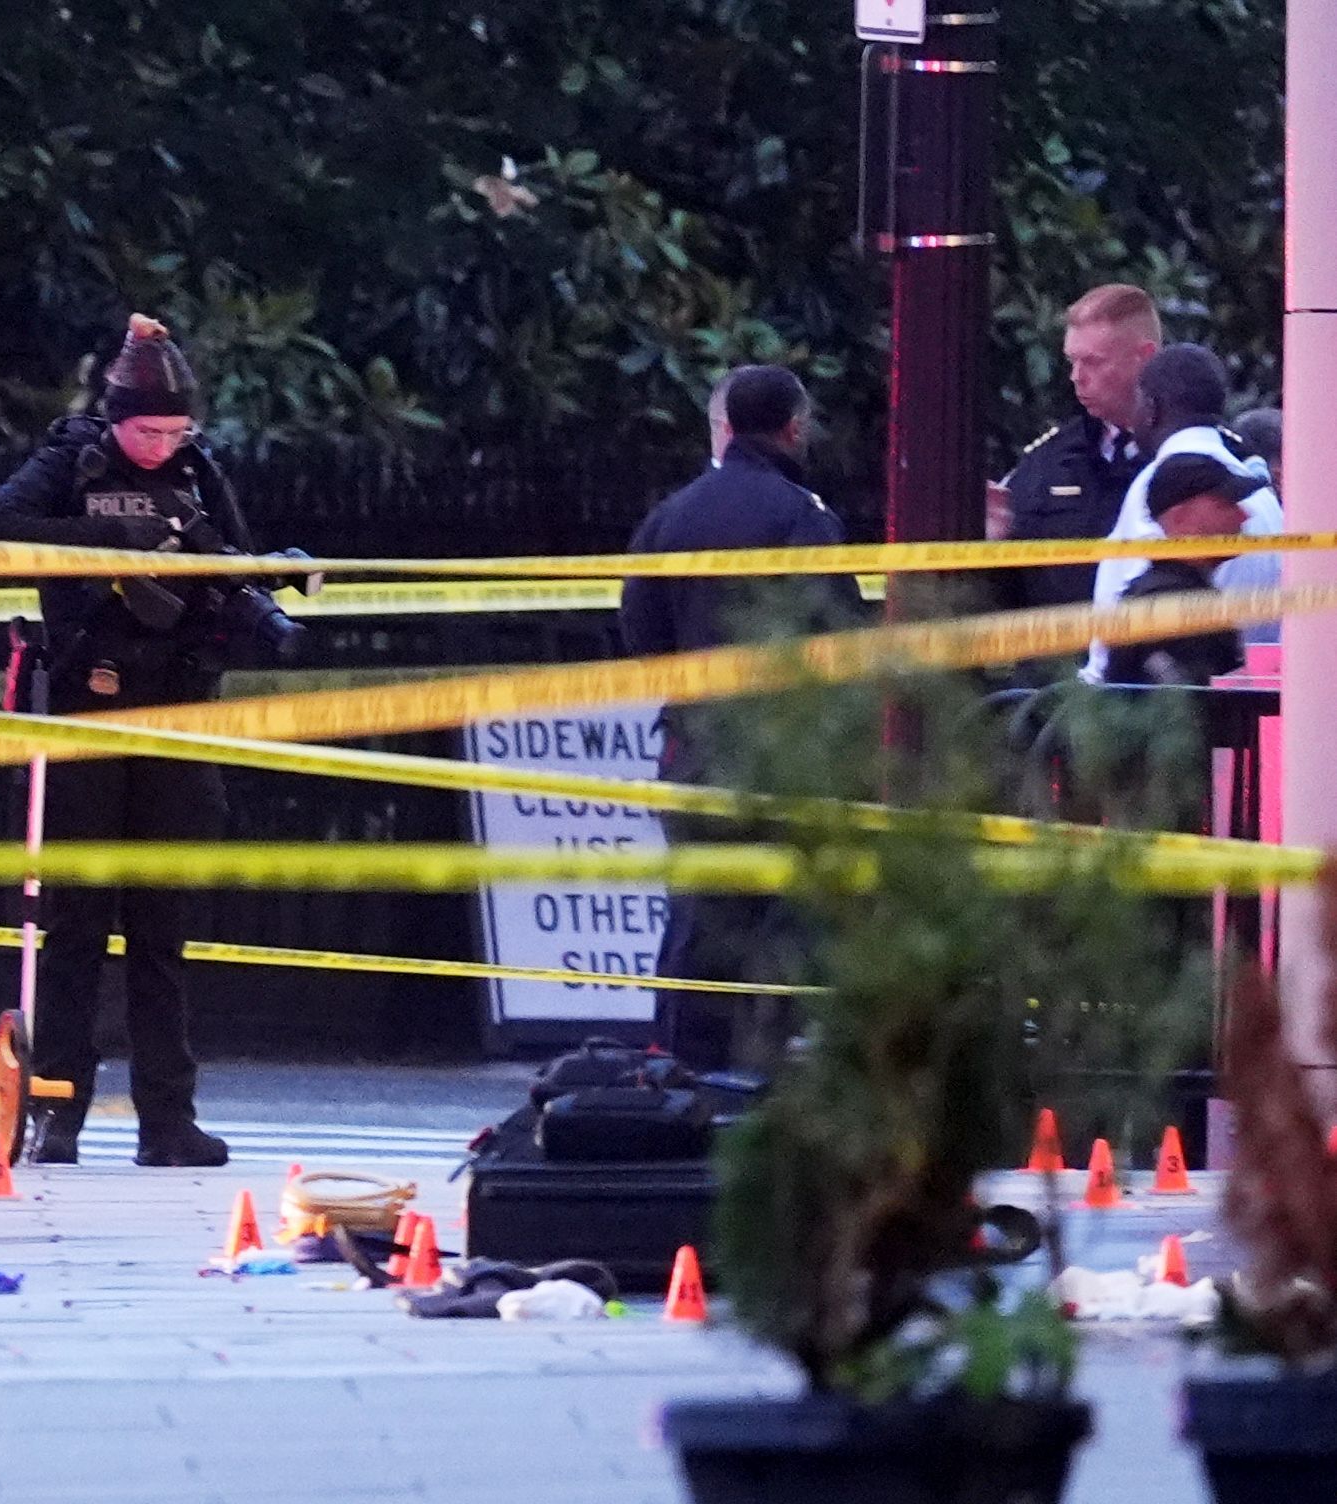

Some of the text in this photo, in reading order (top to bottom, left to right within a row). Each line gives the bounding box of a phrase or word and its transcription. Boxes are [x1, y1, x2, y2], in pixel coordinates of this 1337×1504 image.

[86, 496, 156, 517] POLICE
[486, 719, 663, 761] SIDEWAL
[534, 893, 669, 934] OTHER
[562, 951, 656, 990] SIDE
